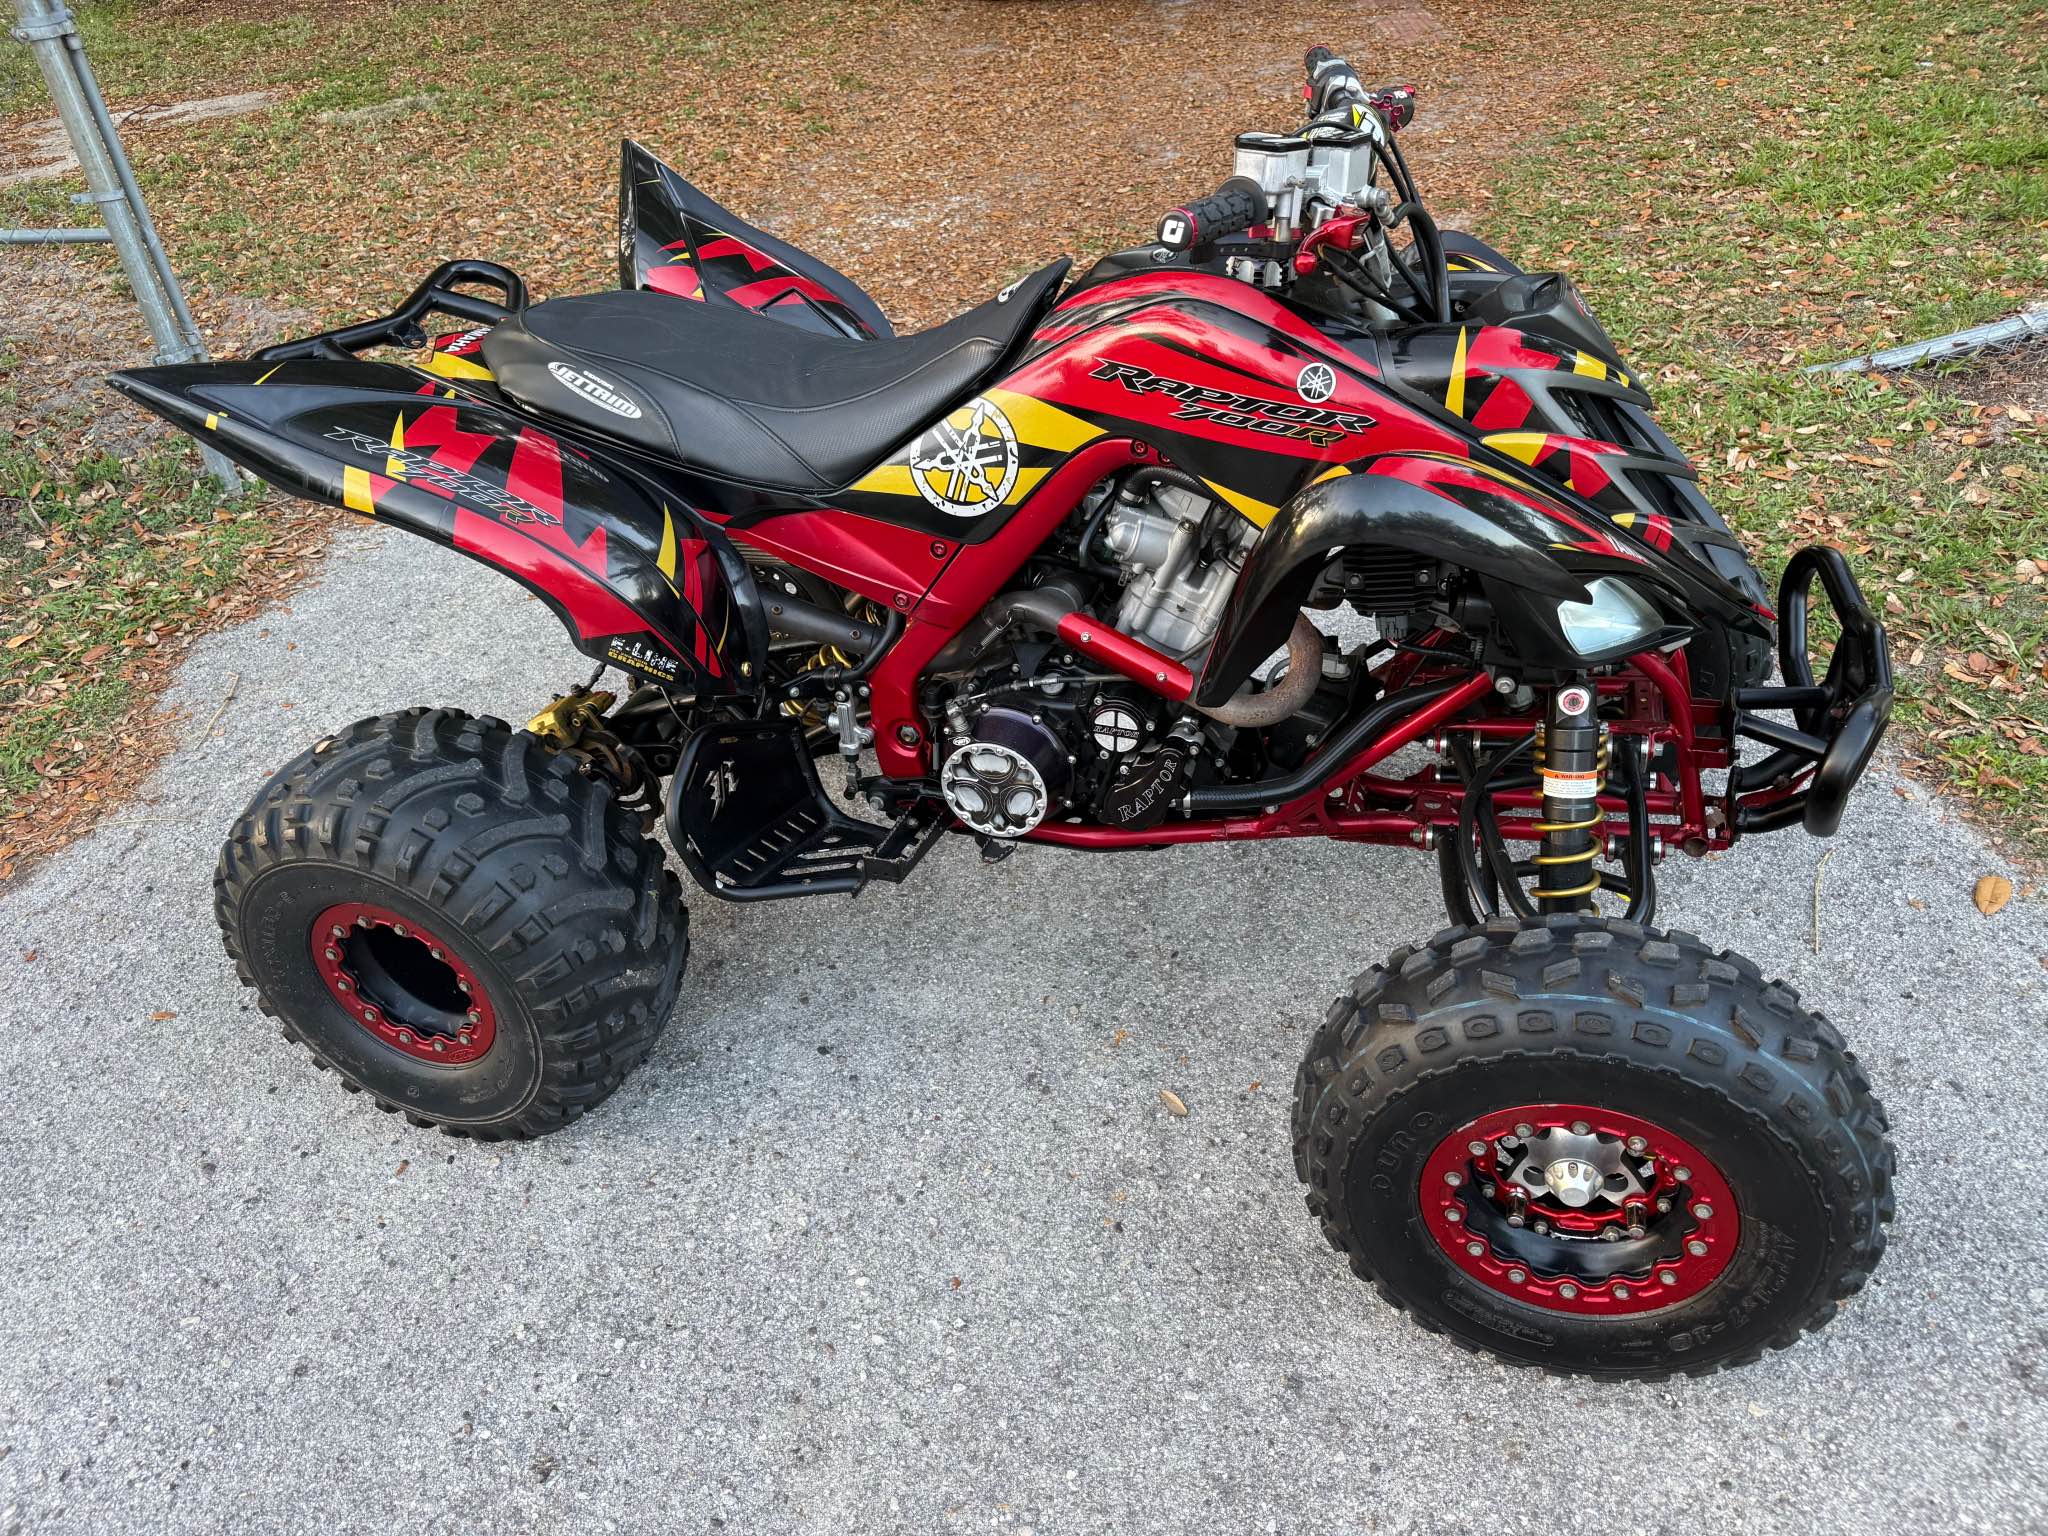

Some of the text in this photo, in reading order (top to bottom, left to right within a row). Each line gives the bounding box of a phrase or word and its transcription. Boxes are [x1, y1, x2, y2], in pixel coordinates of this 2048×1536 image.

[444, 327, 492, 353] AMAHA
[1088, 357, 1377, 434] RAPTOR
[1169, 401, 1349, 447] 700R
[323, 426, 560, 525] RAPTOR
[1093, 725, 1139, 738] RAPTOR
[1118, 759, 1177, 822] RAPTOR
